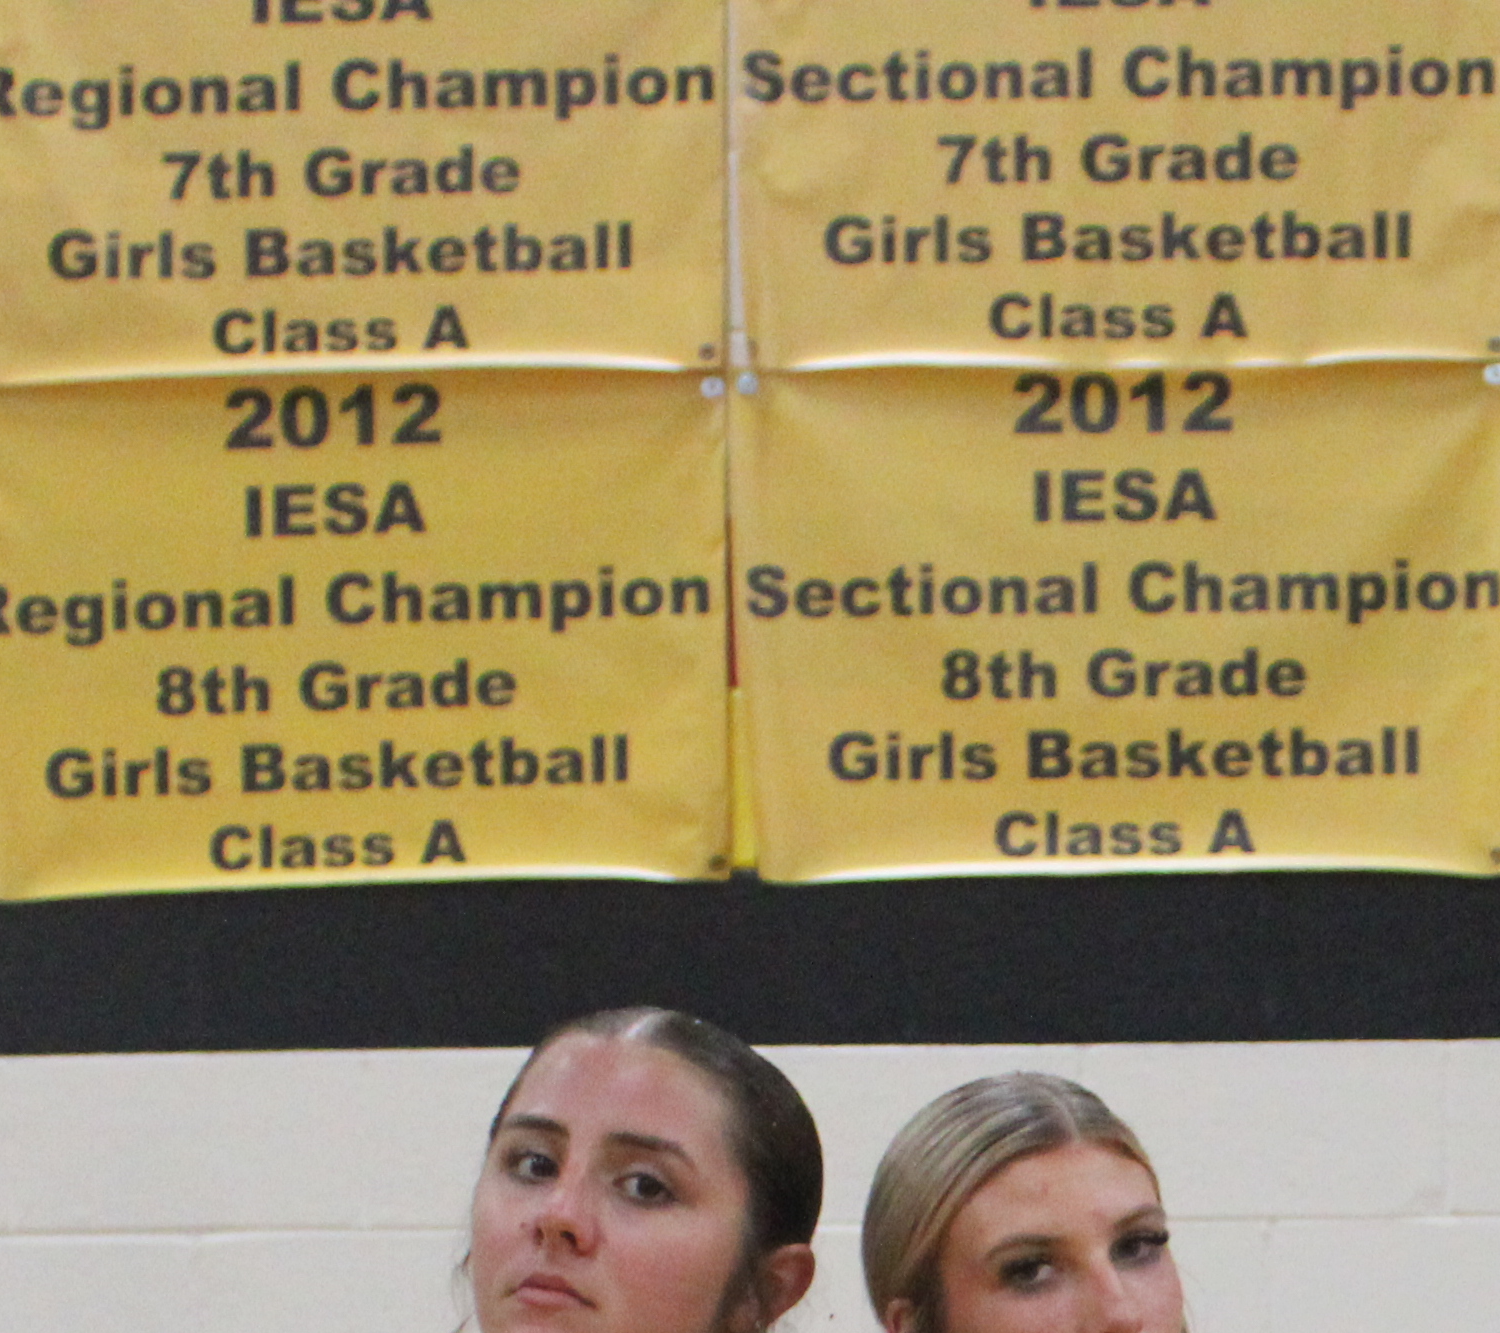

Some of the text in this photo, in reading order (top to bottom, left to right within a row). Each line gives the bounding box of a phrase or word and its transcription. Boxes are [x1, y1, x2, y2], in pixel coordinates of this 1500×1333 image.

[331, 53, 715, 120] Champion
[743, 44, 1495, 111] Sectional Champion
[162, 144, 520, 200] 7th Grade
[937, 132, 1299, 184] 7th Grade
[47, 221, 632, 281] Girls Basketball
[823, 210, 1411, 265] Girls Basketball
[211, 303, 469, 355] Class A
[988, 292, 1247, 340] Class A
[225, 381, 441, 449] 2012
[1013, 371, 1232, 434] 2012
[245, 481, 425, 538] IESA
[1034, 468, 1216, 523] IESA
[325, 566, 710, 633] Champion
[746, 558, 1500, 626] Sectional Champion
[156, 658, 517, 716] 8th Grade
[941, 647, 1307, 701] 8th Grade
[45, 734, 628, 799] Girls Basketball
[828, 727, 1419, 782] Girls Basketball
[208, 818, 467, 871] Class A
[993, 808, 1255, 858] Class A
